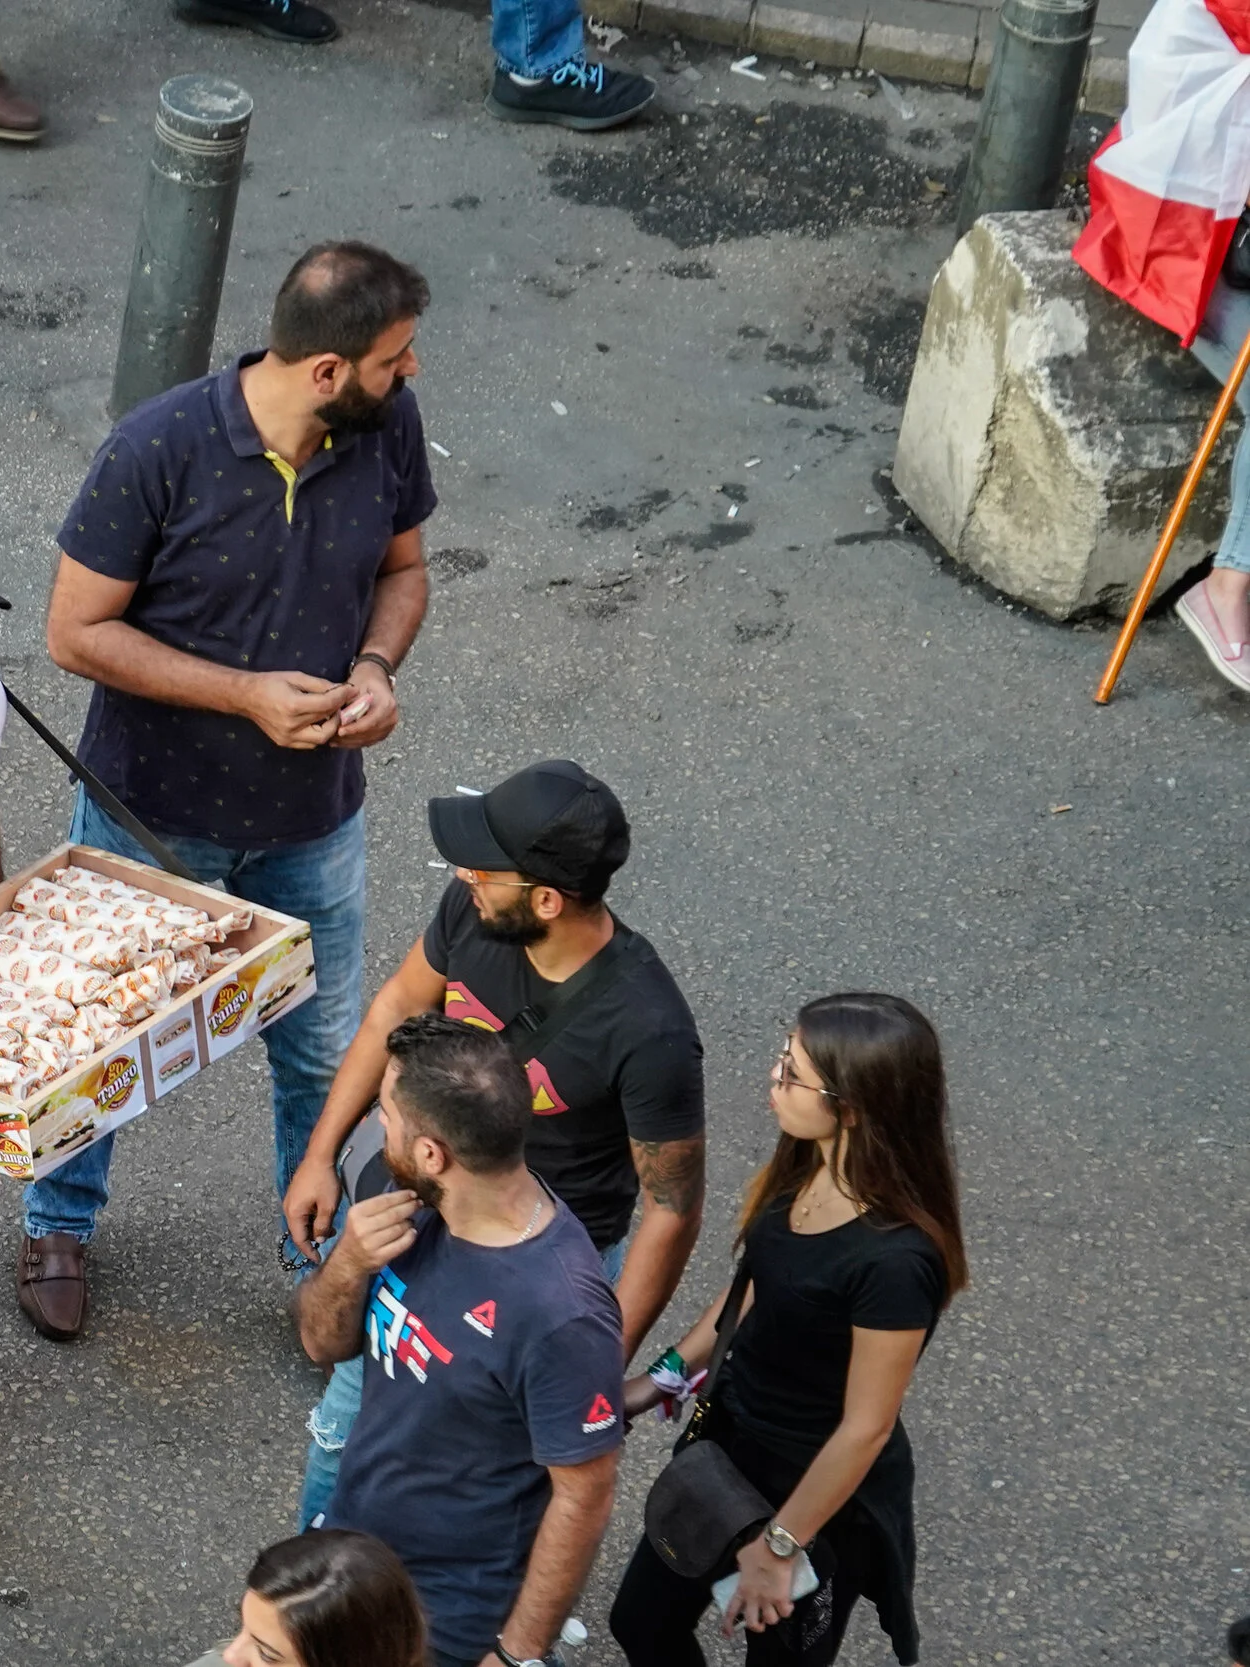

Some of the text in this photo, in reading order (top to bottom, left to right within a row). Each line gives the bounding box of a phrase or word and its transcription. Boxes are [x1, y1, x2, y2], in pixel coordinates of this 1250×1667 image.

[219, 987, 234, 1007] go
[208, 990, 248, 1031] Tango
[108, 1062, 124, 1081] go
[97, 1063, 138, 1105] Tango
[4, 1140, 18, 1152] go
